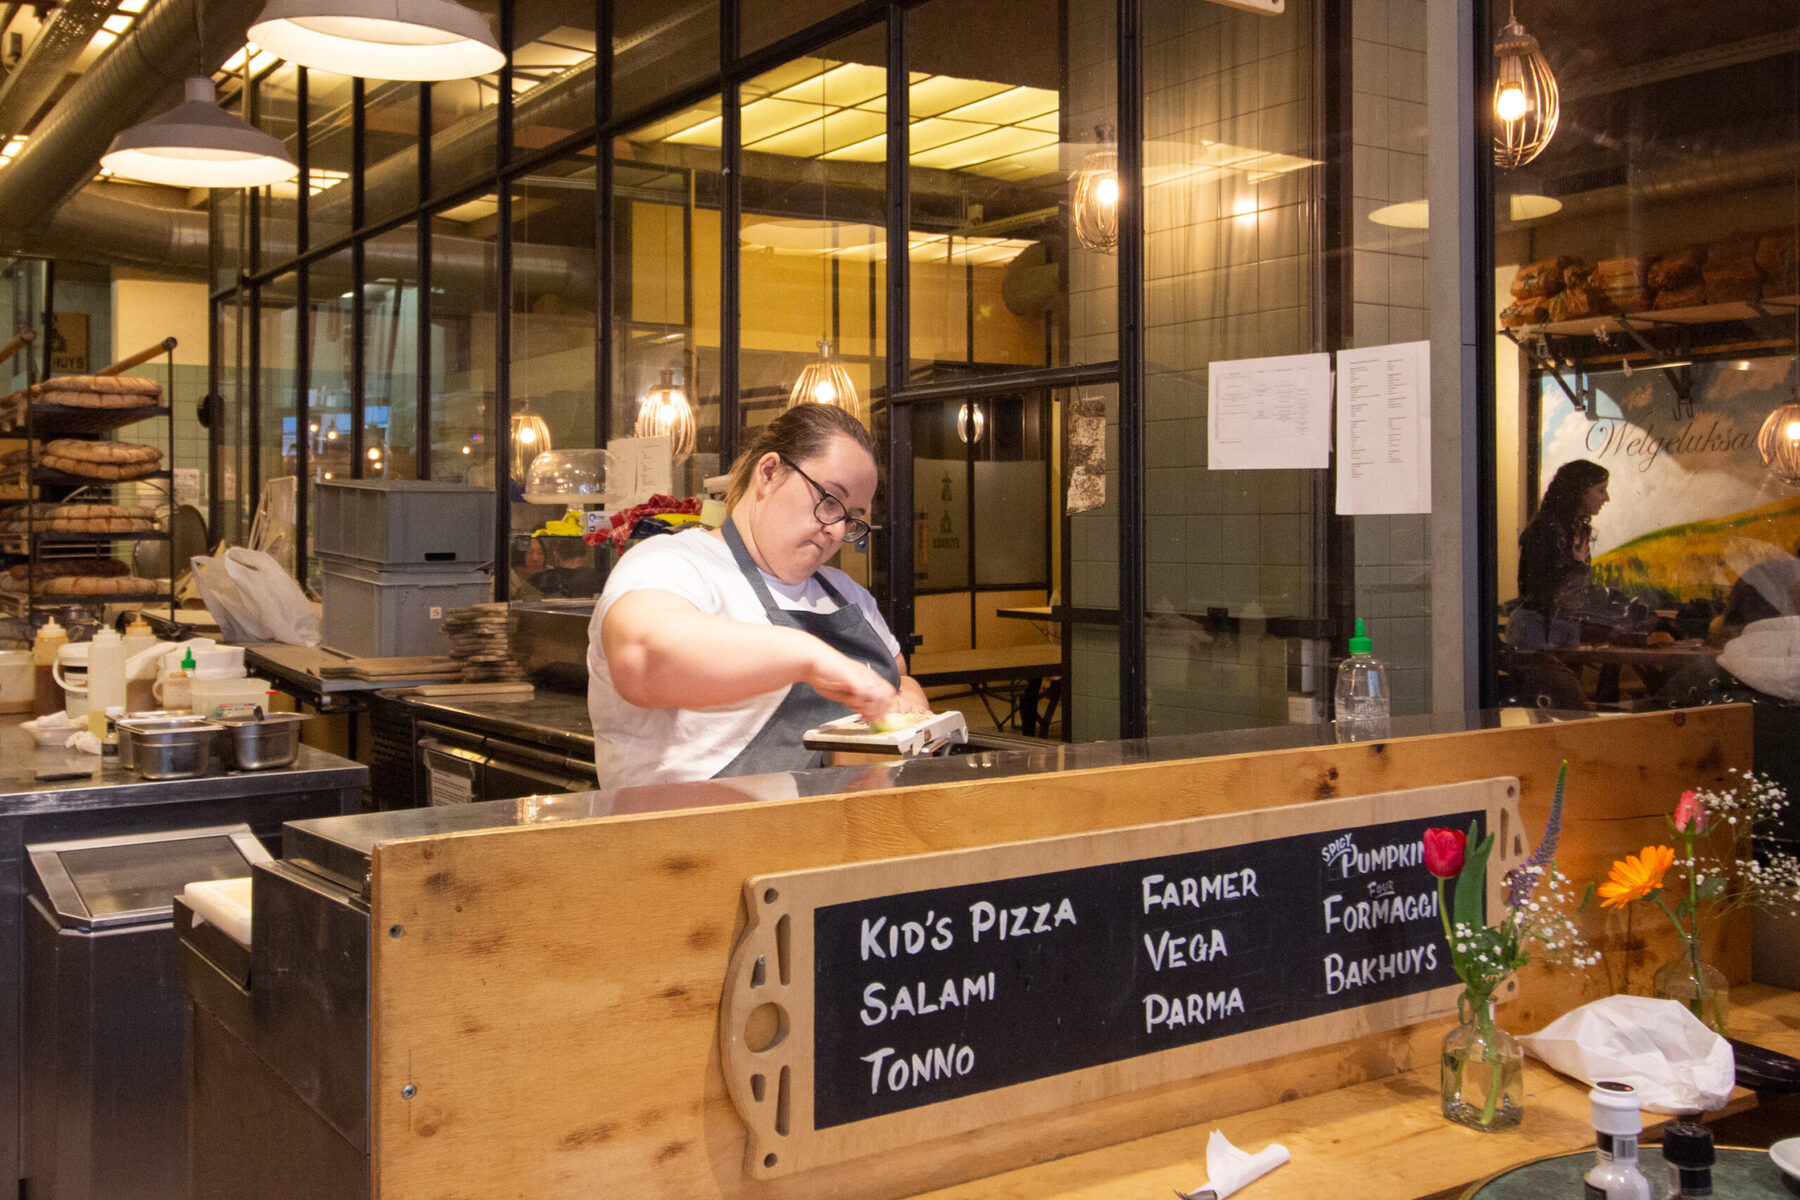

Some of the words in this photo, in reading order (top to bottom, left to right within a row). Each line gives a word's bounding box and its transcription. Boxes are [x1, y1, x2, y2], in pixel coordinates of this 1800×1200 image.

[1585, 410, 1777, 473] Welgeluksa
[1321, 833, 1353, 863] SPICY
[1141, 868, 1260, 915] FARMER
[1323, 890, 1439, 934] FORMAGGI
[1366, 880, 1395, 898] FOUR
[860, 910, 953, 961] KID'S
[969, 897, 1078, 943] PIZZA
[1143, 928, 1229, 972] VEGA
[1323, 943, 1438, 995] BAKHUYS
[860, 971, 996, 1026] SALAMI
[1142, 987, 1246, 1034] PARMA
[859, 1043, 975, 1095] TONNO
